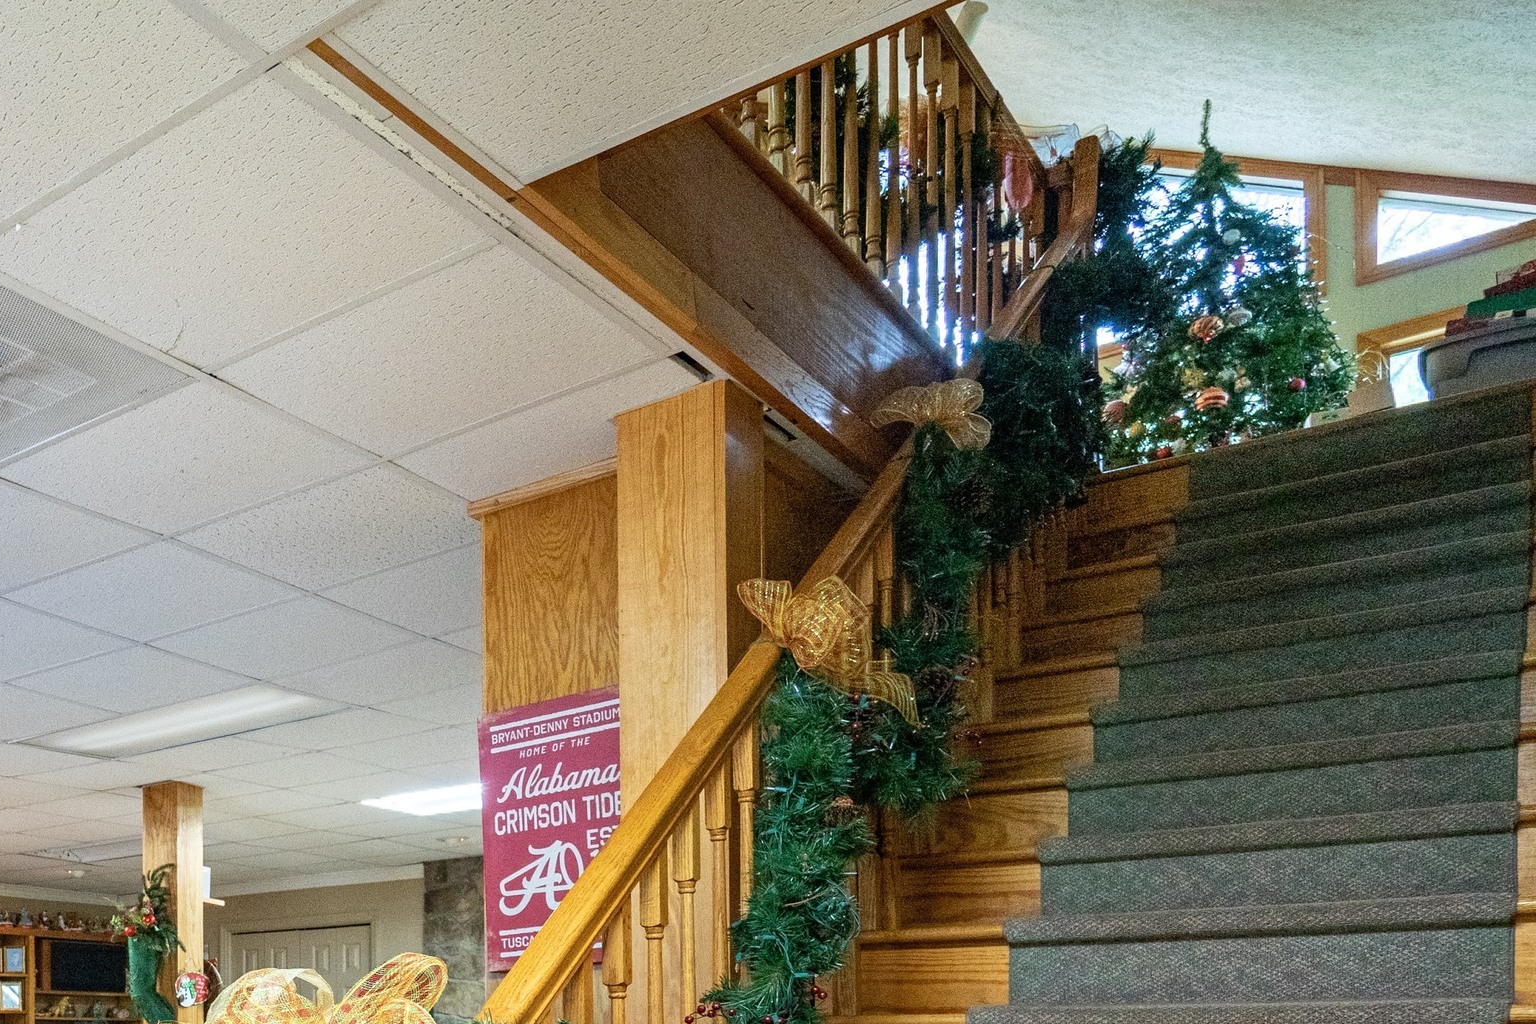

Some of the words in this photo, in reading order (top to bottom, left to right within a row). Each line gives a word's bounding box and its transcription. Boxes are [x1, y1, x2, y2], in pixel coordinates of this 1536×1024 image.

[491, 718, 569, 745] BRYANT-DENNY
[573, 707, 620, 727] STADIUM
[519, 745, 547, 758] HOME
[552, 741, 565, 752] OF
[571, 736, 591, 748] THE
[497, 762, 620, 804] Alabama
[494, 799, 577, 836] CRIMSON
[582, 790, 621, 821] TIDE
[586, 825, 619, 849] ES
